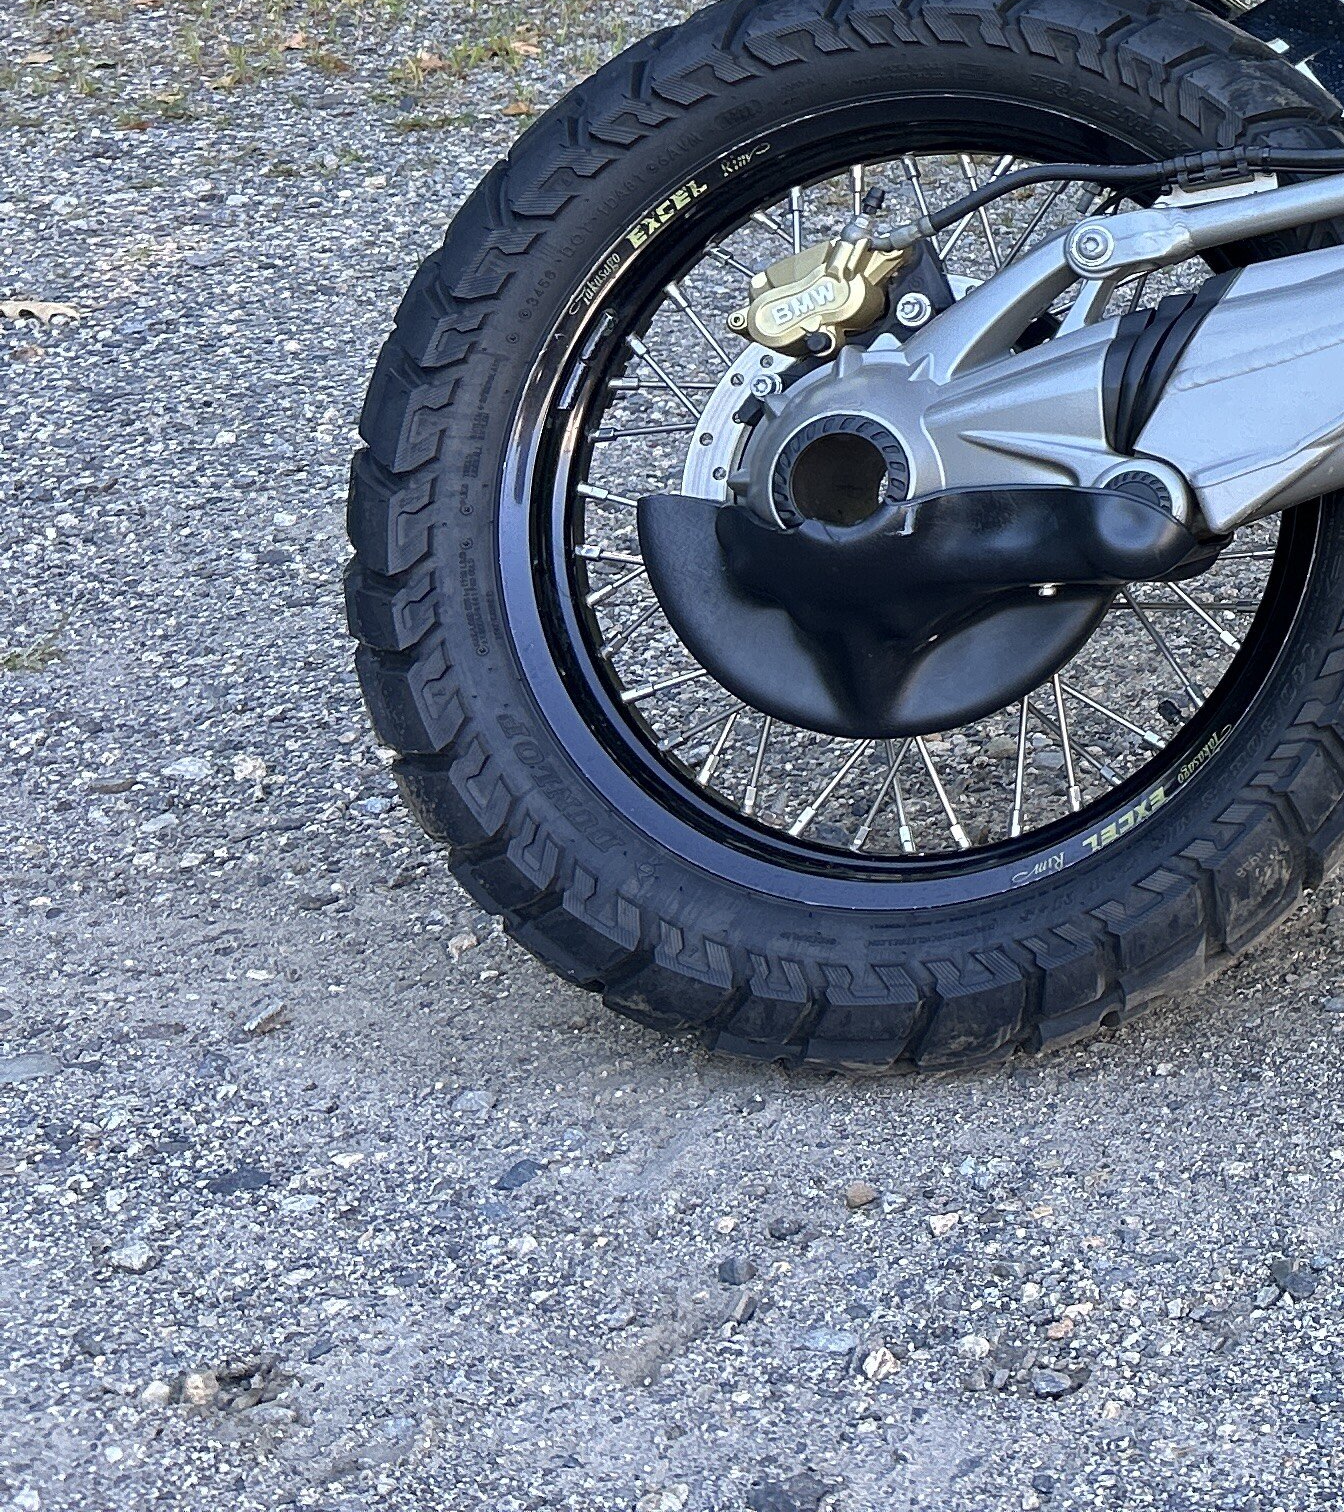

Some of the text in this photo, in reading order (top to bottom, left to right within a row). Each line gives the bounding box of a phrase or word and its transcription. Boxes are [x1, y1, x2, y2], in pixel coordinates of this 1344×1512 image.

[568, 142, 771, 316] Takasago EXCEL Rim
[771, 281, 835, 326] BMW
[496, 713, 627, 854] DUNLOP
[1010, 723, 1233, 883] Takasago EXCEL Rim
